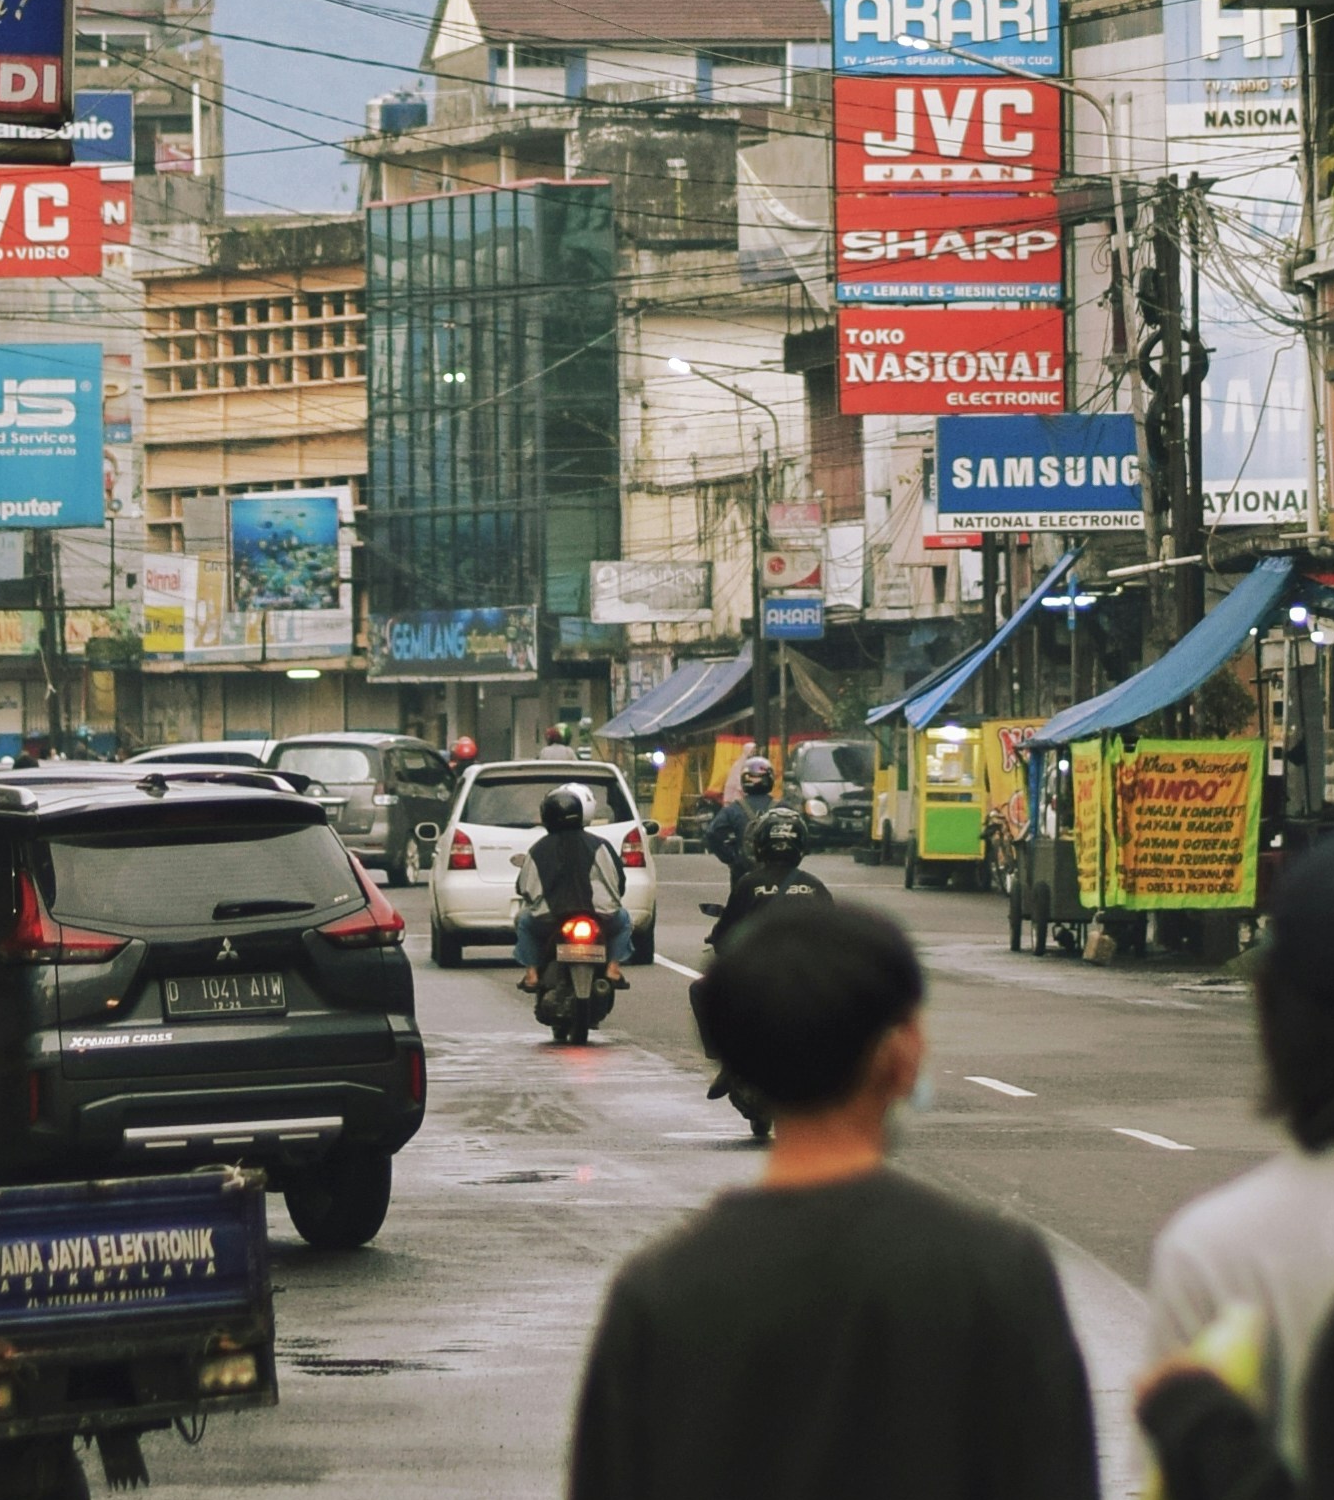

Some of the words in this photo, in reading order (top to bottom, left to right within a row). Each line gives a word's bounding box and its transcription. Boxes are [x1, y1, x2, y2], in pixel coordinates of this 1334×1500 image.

[905, 56, 955, 66] SPEAKER
[863, 88, 1034, 158] JVC
[883, 167, 1015, 180] JAPAN
[842, 230, 1058, 261] SHARP
[873, 285, 924, 297] LEMARI
[954, 285, 996, 298] MESIN
[845, 328, 905, 346] TOKO
[845, 351, 1061, 383] NASIONAL
[945, 391, 1061, 406] ELECTRONIC
[10, 431, 76, 445] Services
[953, 516, 1033, 529] NATIONAL
[1039, 514, 1140, 528] ELECTRONIC
[168, 981, 179, 1002] D
[201, 977, 240, 1000] 1041
[69, 1034, 130, 1049] XPANDER
[132, 1032, 173, 1043] CROSS
[48, 1236, 96, 1273] JAYA
[96, 1227, 215, 1267] ELEKTRONIK
